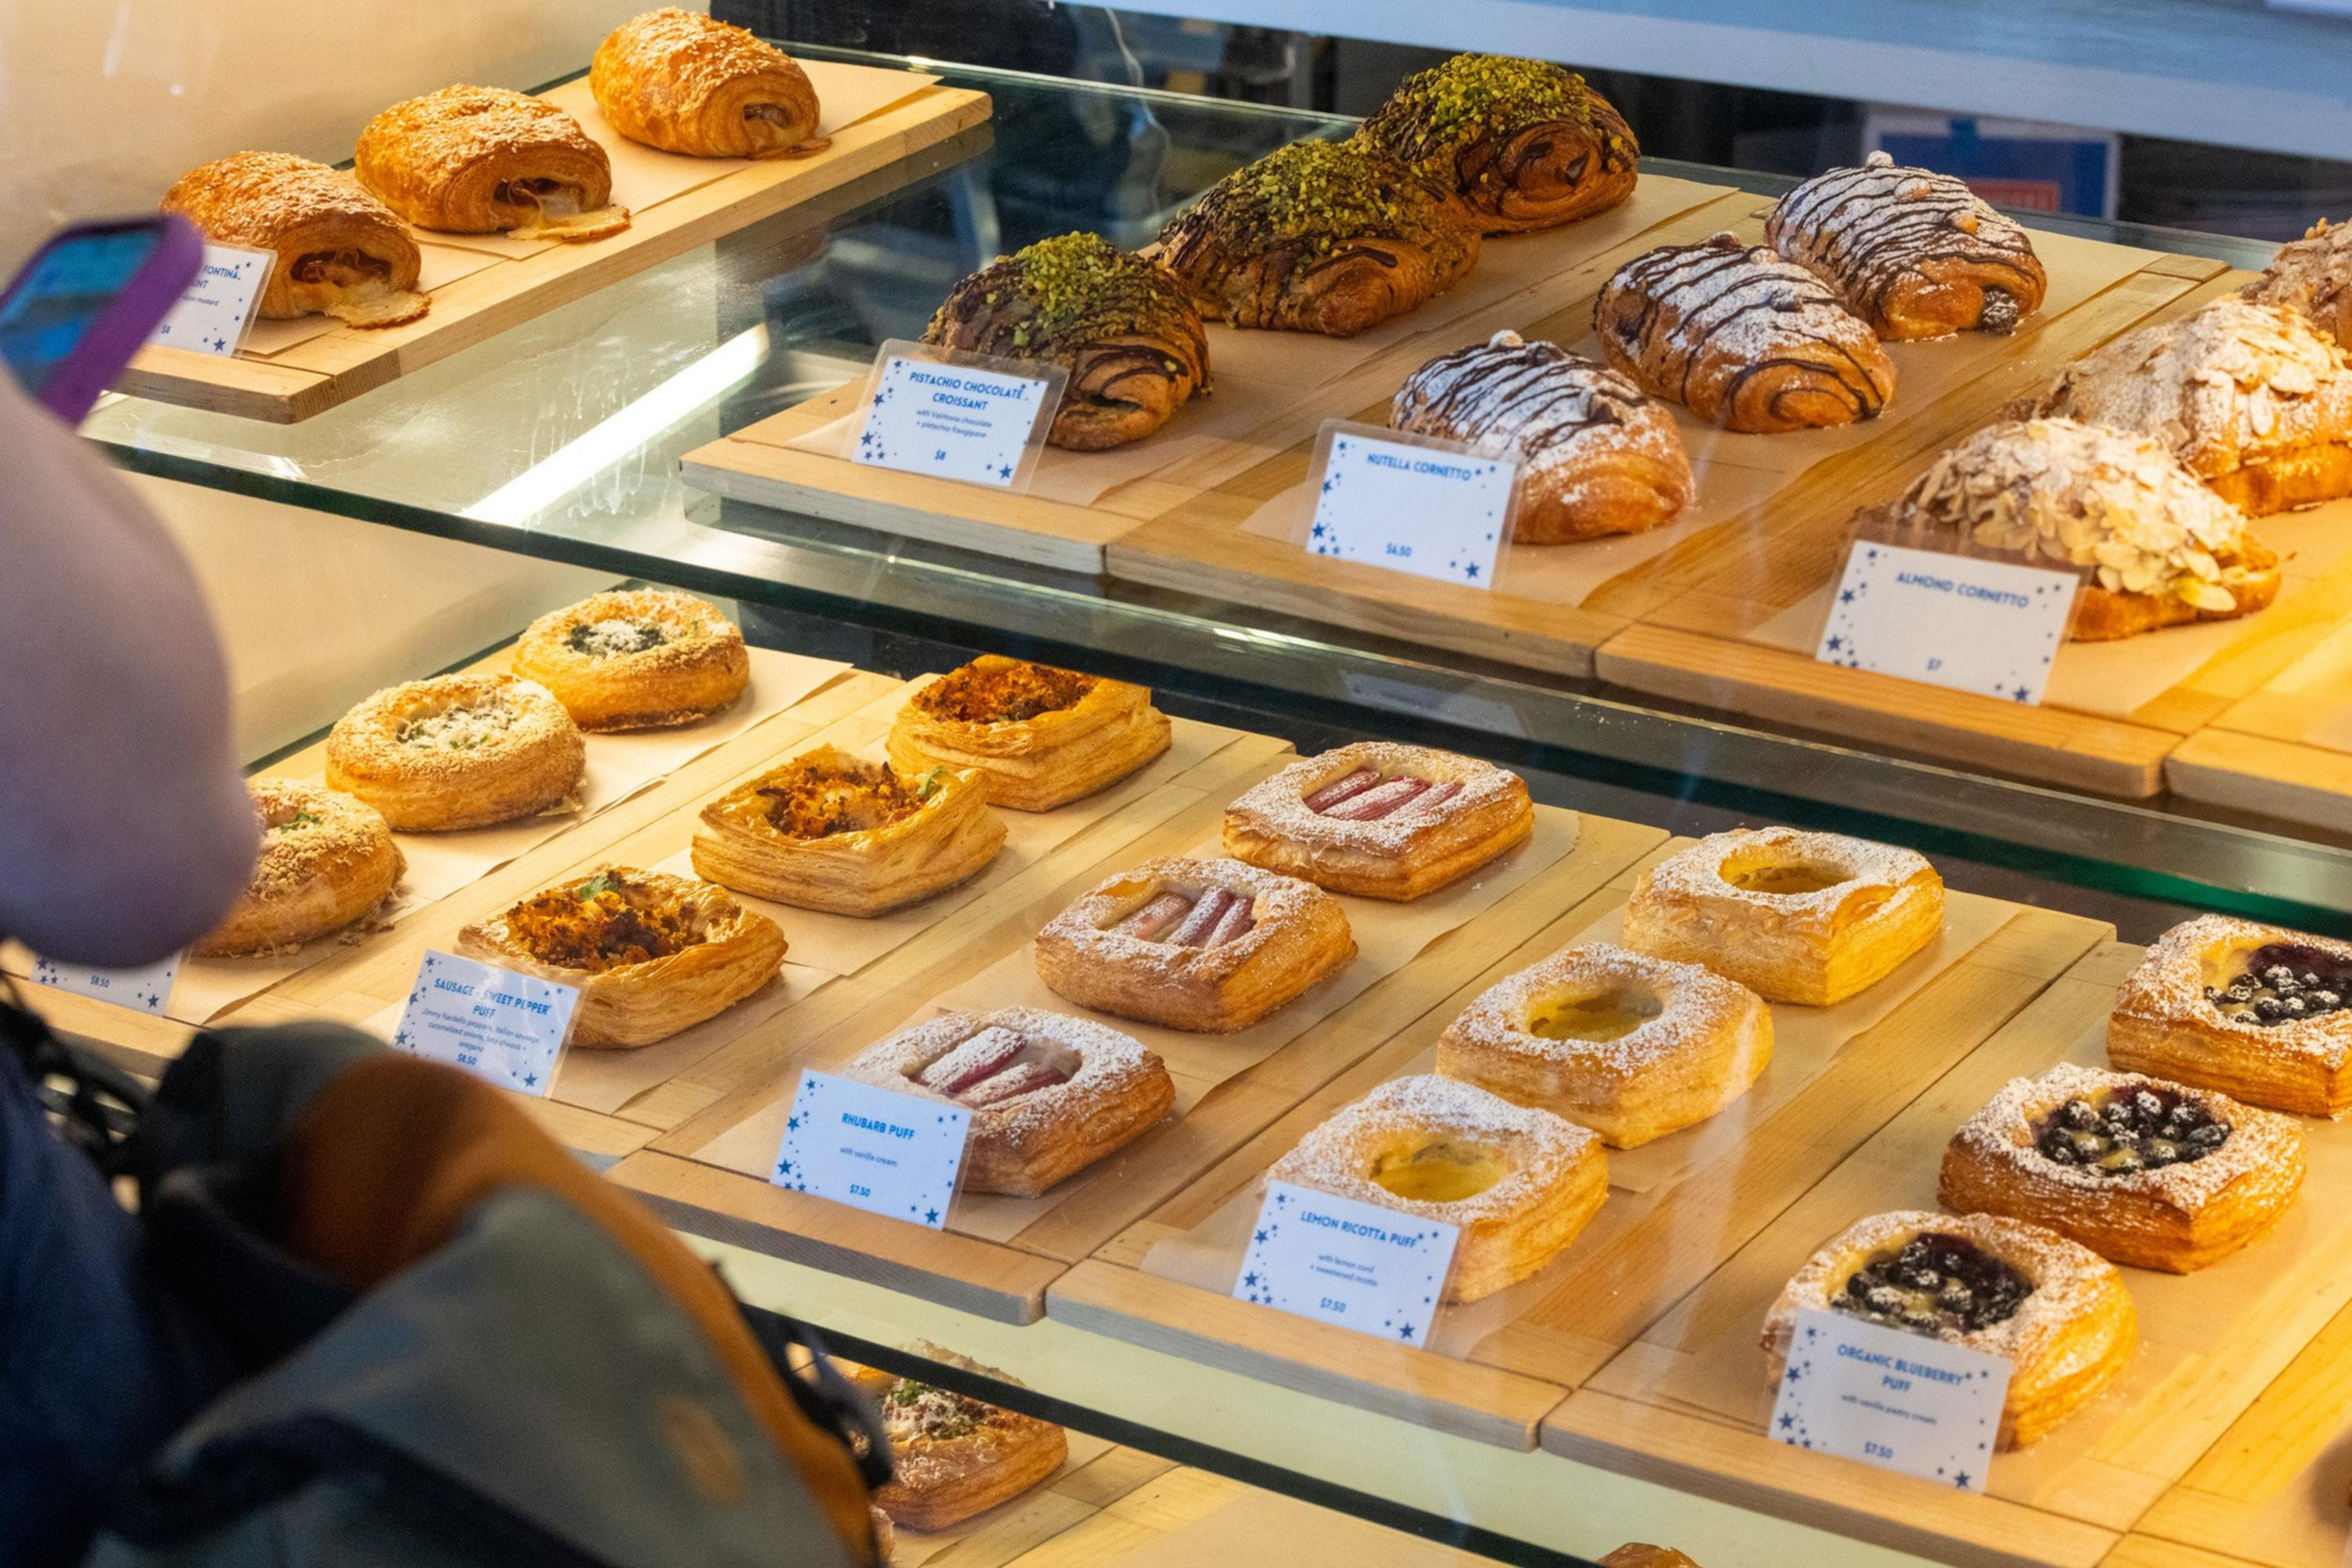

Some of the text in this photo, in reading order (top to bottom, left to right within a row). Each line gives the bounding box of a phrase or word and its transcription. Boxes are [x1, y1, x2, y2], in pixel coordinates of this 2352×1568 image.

[197, 297, 220, 306] mustard
[162, 325, 171, 334] $8
[910, 372, 1023, 399] PISTACHIO CHOCOLATE
[932, 393, 988, 410] CROISSANT
[921, 422, 951, 432] pistachio
[952, 426, 987, 438] frangipane
[961, 417, 992, 428] chocolate
[934, 449, 946, 461] $8
[1366, 453, 1471, 481] NUTELLA CORNETTO
[1896, 572, 2029, 608] ALMOND CORNETTO
[434, 978, 549, 1015] SAUSAGE SWEET PEPPER
[421, 1008, 440, 1020] Jimmy
[472, 1005, 496, 1018] PUFF
[458, 1041, 484, 1052] oregano
[499, 1039, 521, 1050] cheese
[458, 1053, 477, 1065] $8.50
[841, 1112, 915, 1140] RHUBARB PUFF
[854, 1152, 875, 1161] vanilla
[876, 1156, 897, 1167] cream
[850, 1183, 870, 1197] $7.50
[1300, 1210, 1417, 1249] LEMON RICOTTA PUFF
[1335, 1257, 1355, 1268] lemon
[1357, 1264, 1374, 1273] curd
[1316, 1267, 1354, 1280] sweetened
[1355, 1276, 1378, 1286] ricotta
[1320, 1297, 1346, 1313] $7.50
[1838, 1344, 1963, 1386] ORGANIC BLUEBERRY
[1881, 1375, 1912, 1392] PUFF
[1842, 1394, 1857, 1403] with
[1860, 1400, 1883, 1410] vanilla
[1912, 1414, 1937, 1425] cream
[1864, 1441, 1893, 1459] $7.50
